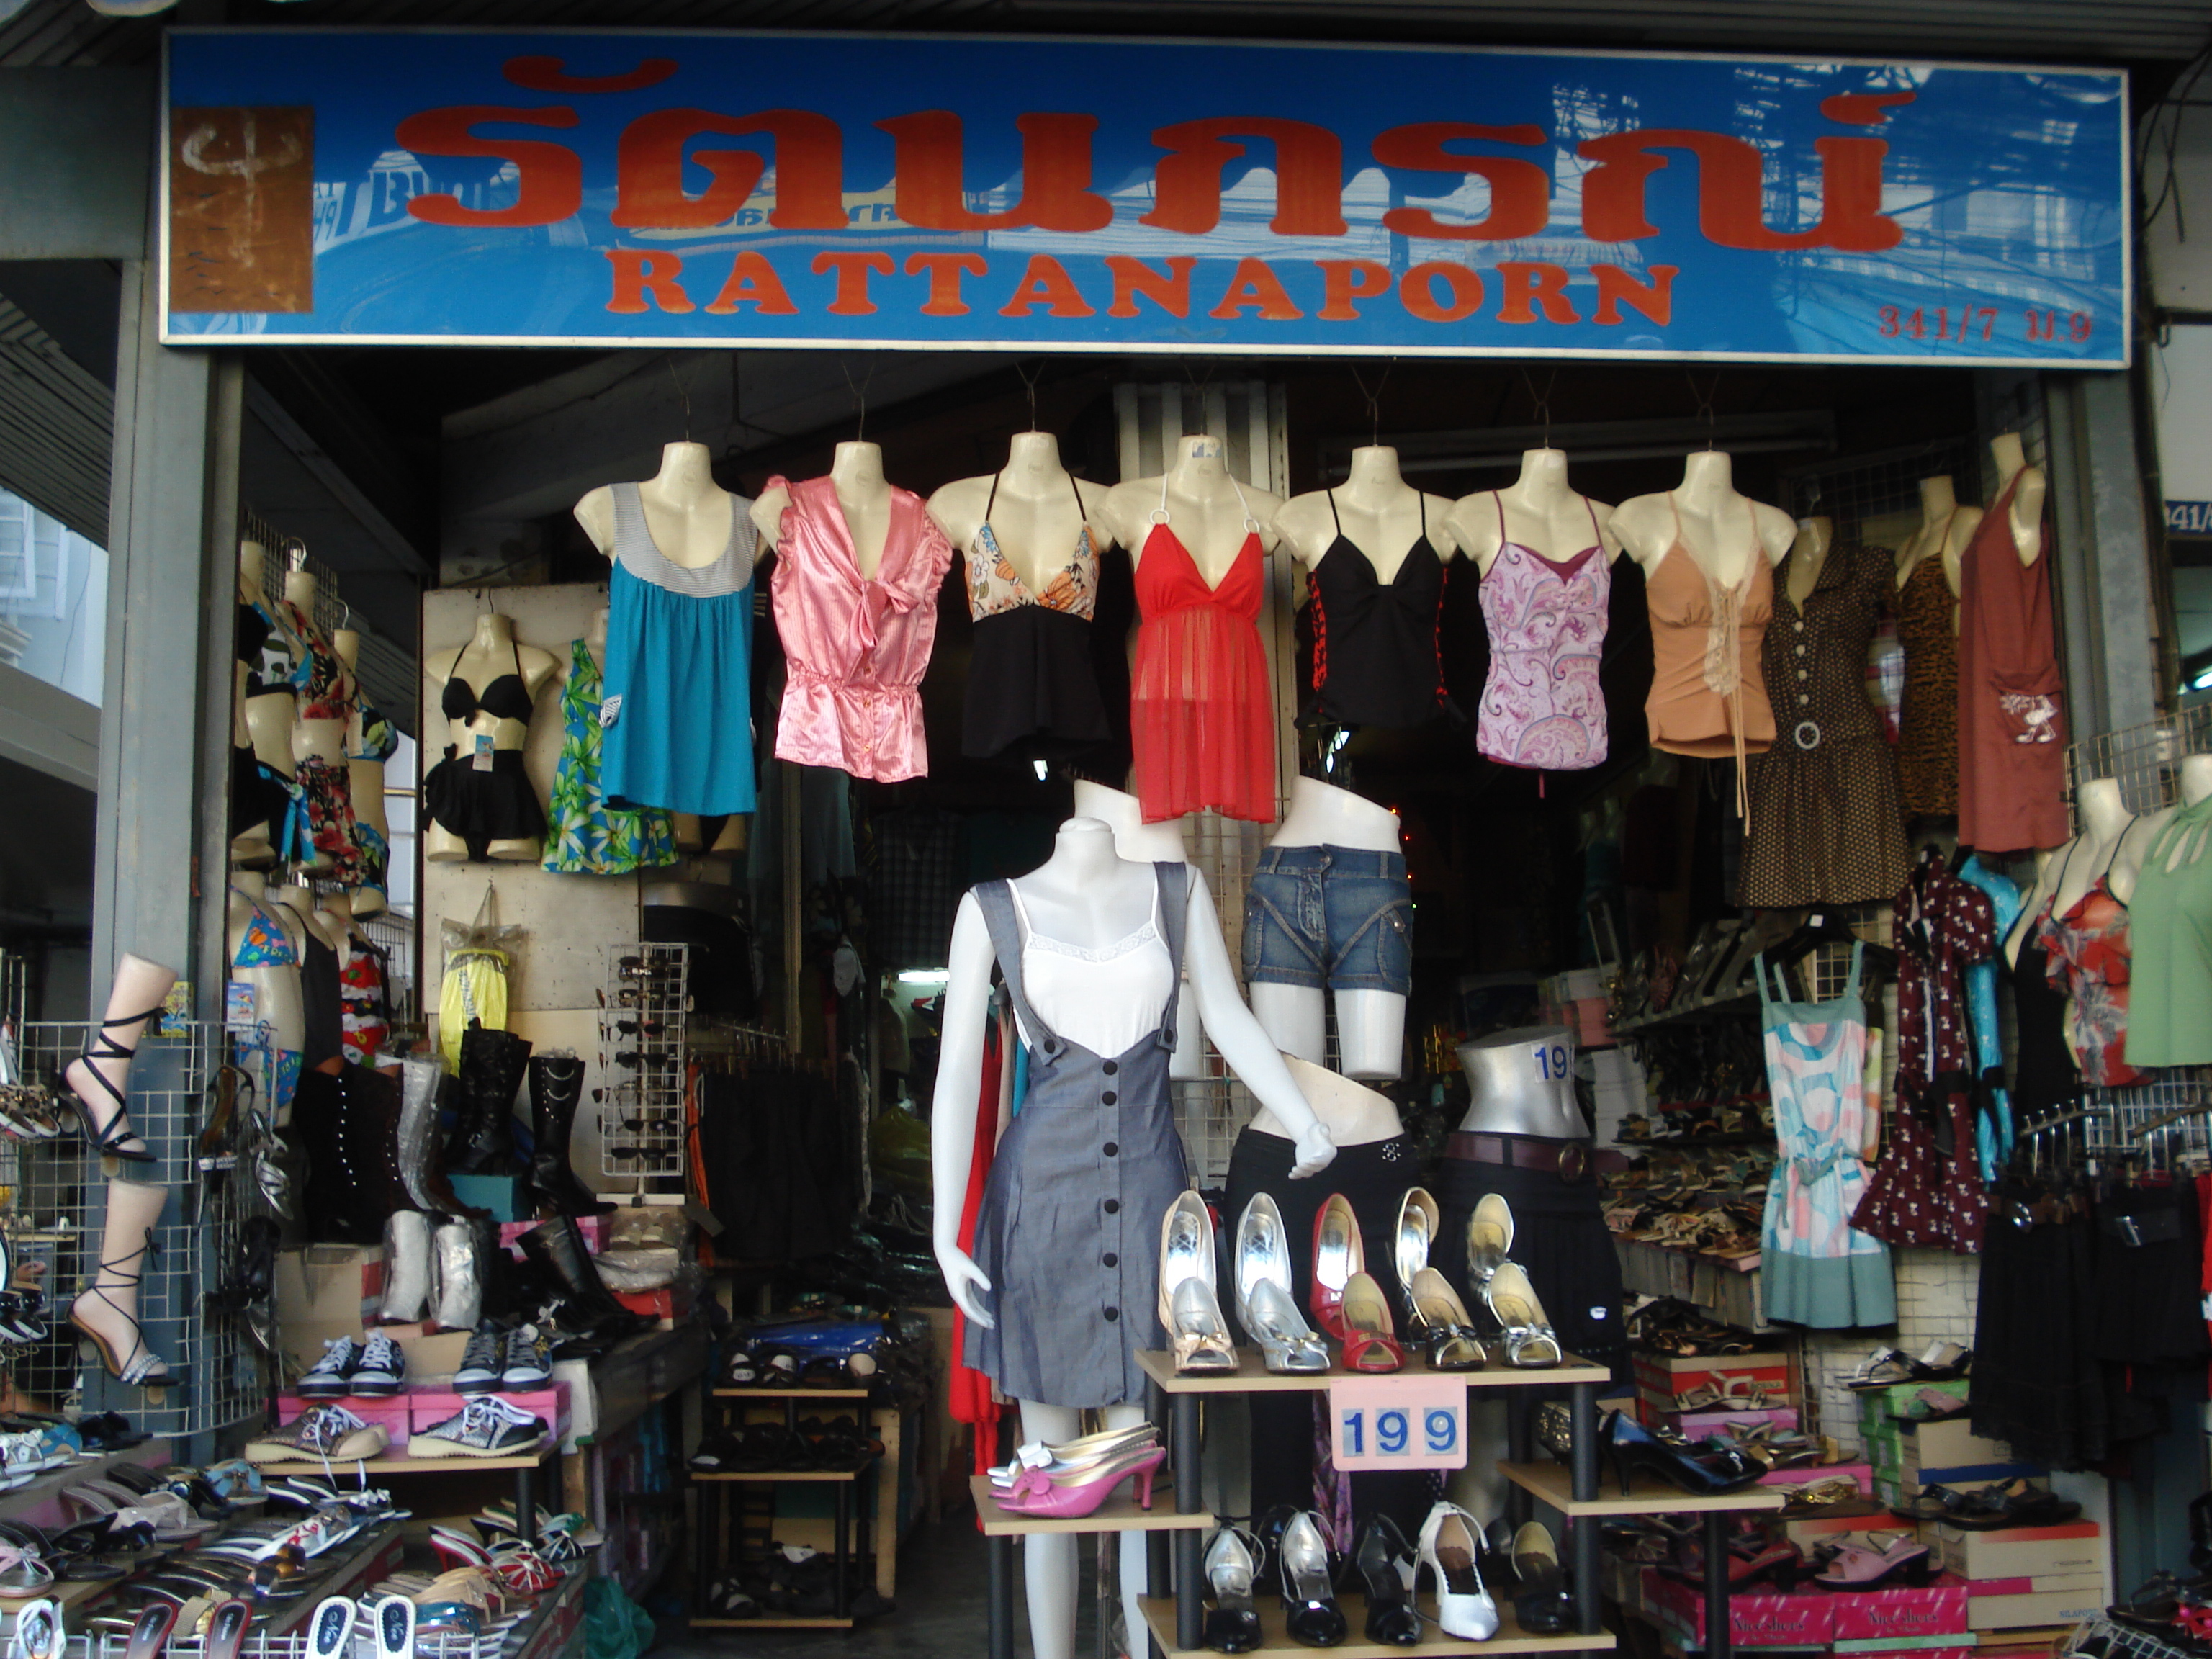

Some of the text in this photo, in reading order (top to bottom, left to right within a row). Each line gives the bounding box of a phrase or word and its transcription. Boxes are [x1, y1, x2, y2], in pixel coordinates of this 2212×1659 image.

[606, 250, 1680, 328] RATTANAPORN
[1879, 304, 1998, 343] 341/7
[1344, 1411, 1456, 1452] 199
